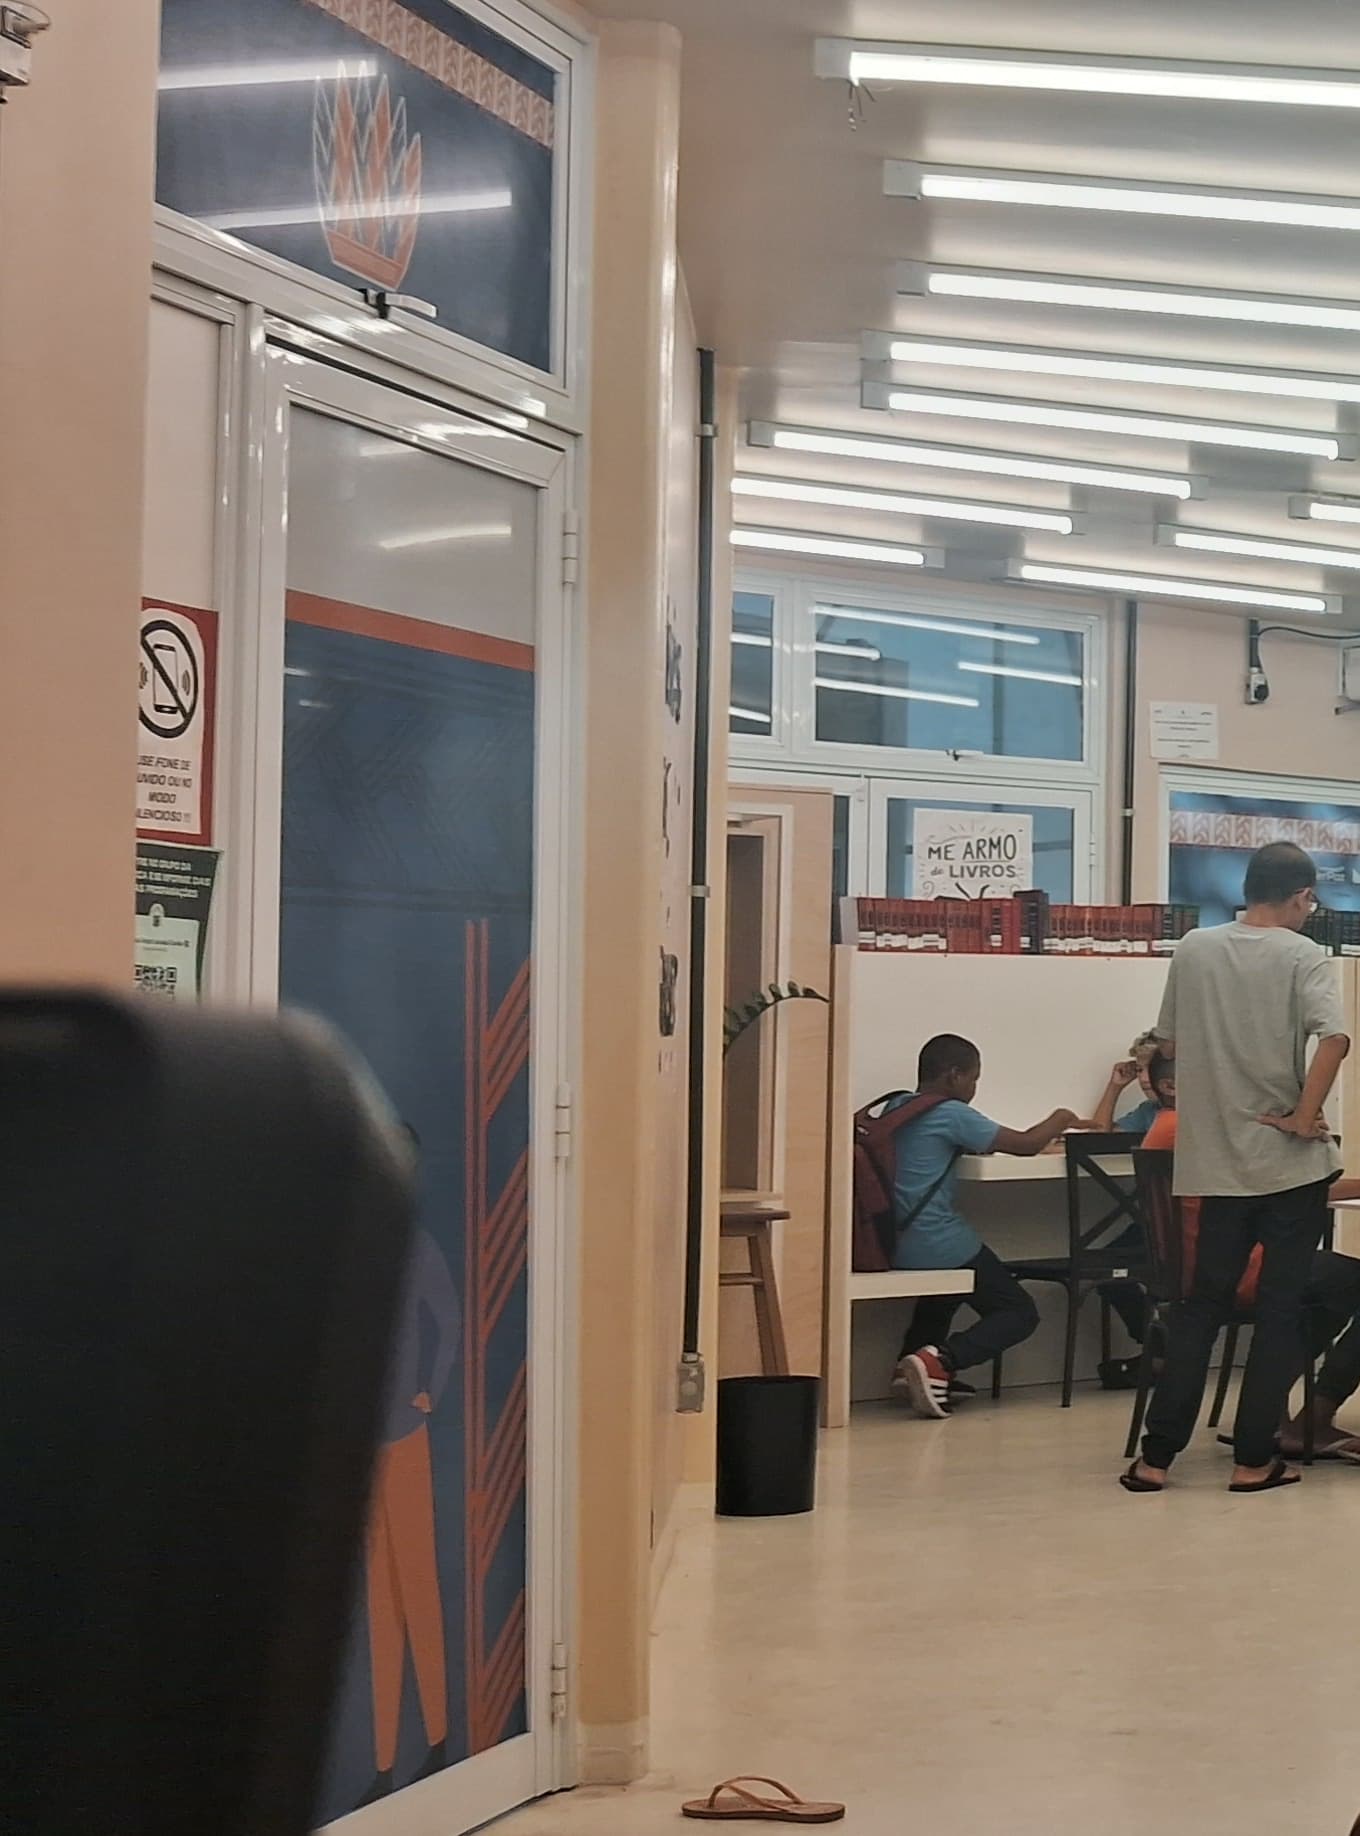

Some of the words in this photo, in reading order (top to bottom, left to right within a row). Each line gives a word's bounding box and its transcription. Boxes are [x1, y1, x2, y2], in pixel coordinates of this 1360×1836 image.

[137, 773, 166, 785] UVIDO
[148, 791, 176, 804] MODO
[928, 843, 956, 861] ME
[962, 834, 1017, 861] ARMO
[930, 866, 944, 877] de
[949, 864, 1017, 879] LIVROS
